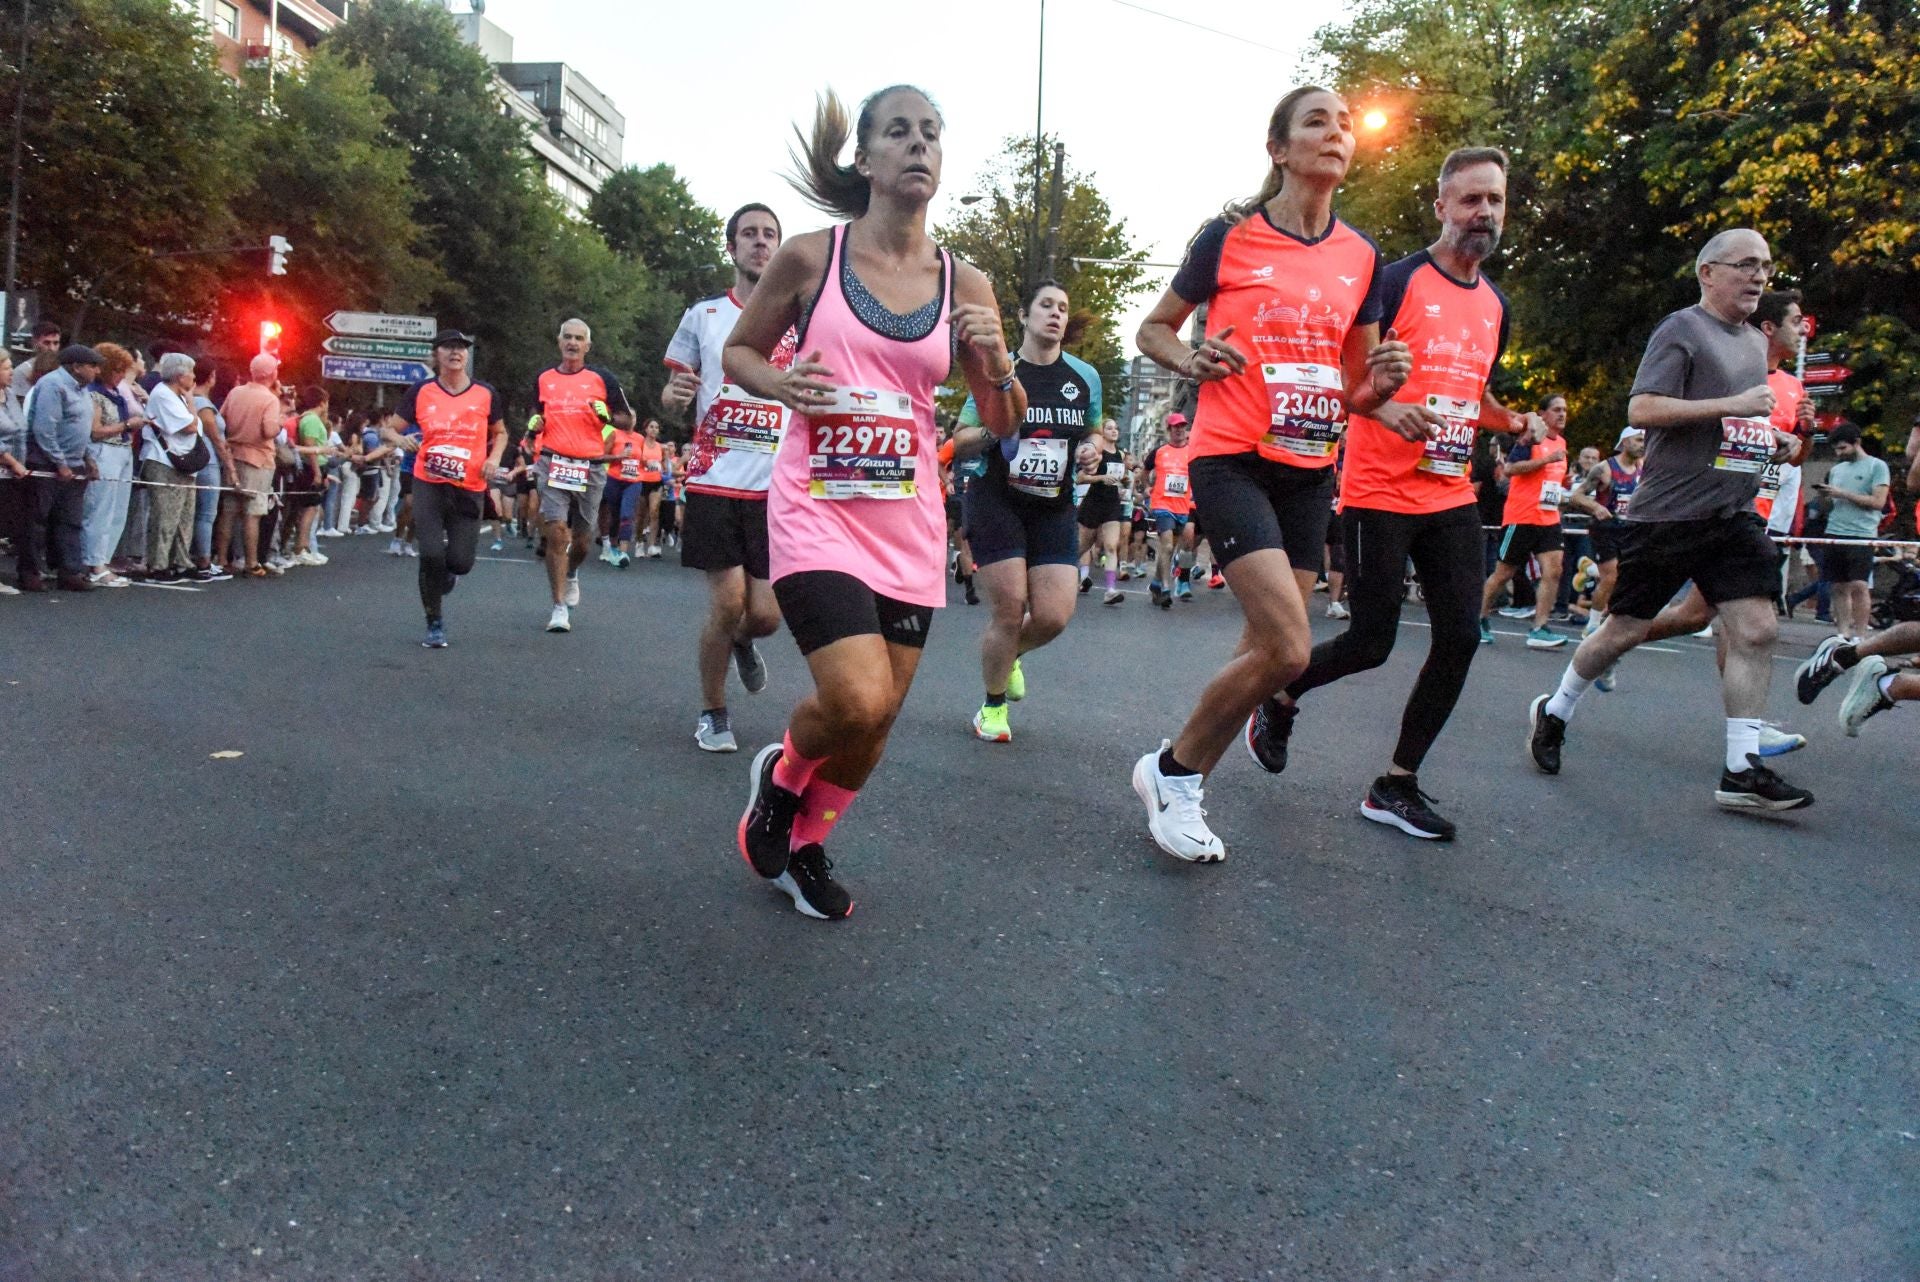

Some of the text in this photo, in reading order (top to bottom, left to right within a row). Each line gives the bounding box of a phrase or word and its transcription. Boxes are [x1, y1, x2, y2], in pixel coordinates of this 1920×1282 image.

[722, 406, 778, 428] 22759
[1275, 391, 1341, 421] 23409
[816, 425, 911, 455] 22978
[1726, 425, 1773, 447] 24220
[426, 454, 465, 472] 23296
[1019, 458, 1059, 474] 6713
